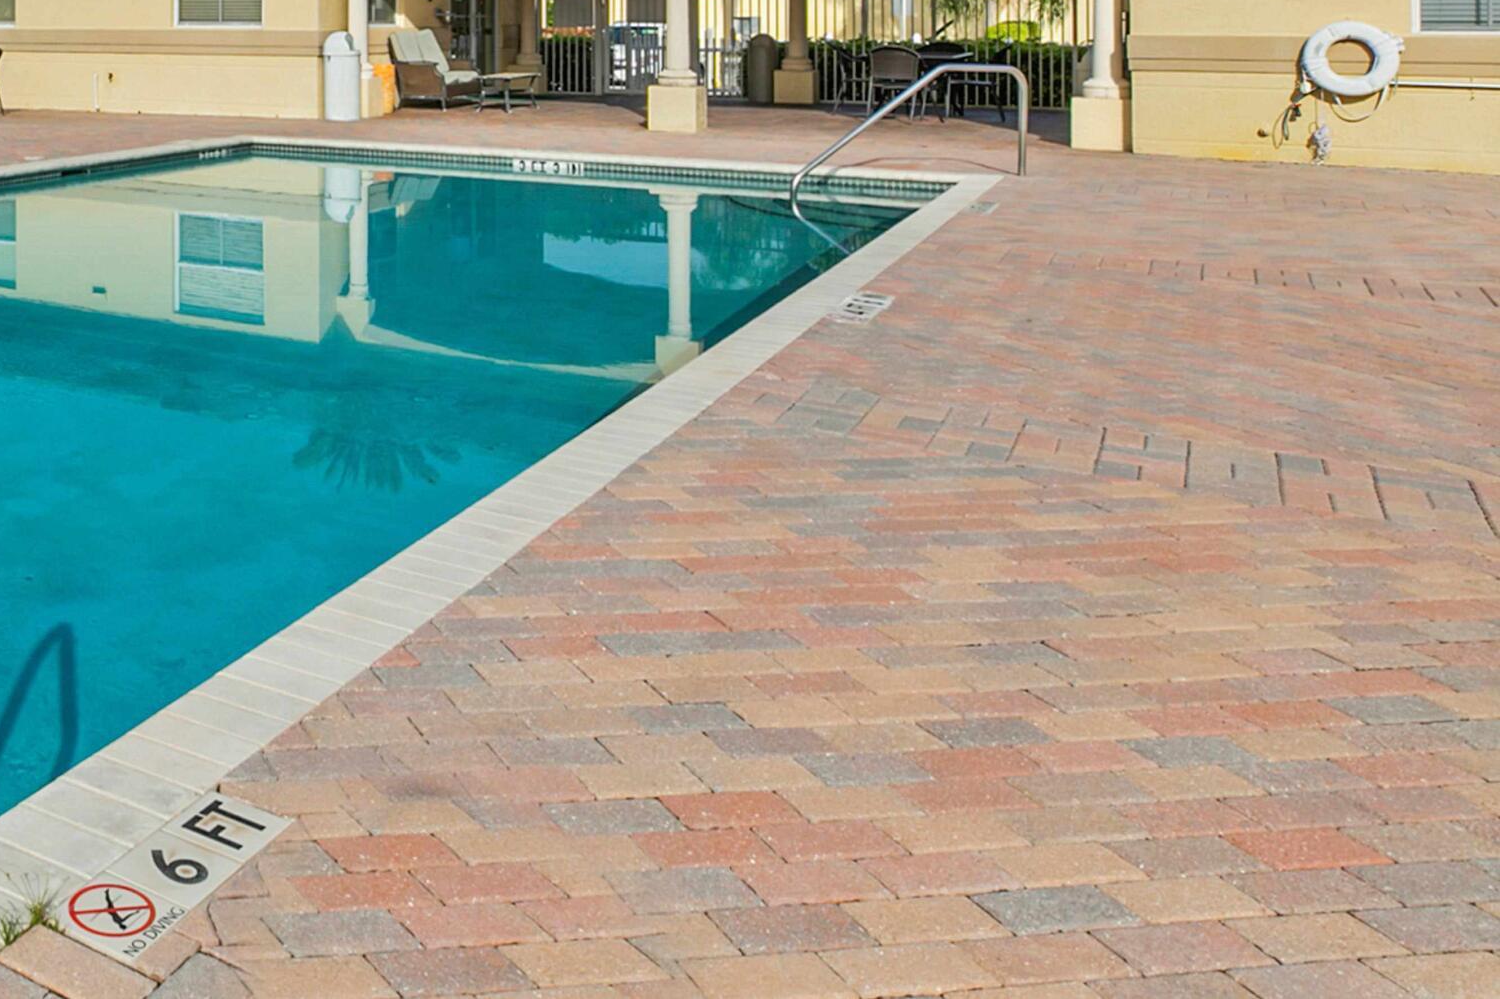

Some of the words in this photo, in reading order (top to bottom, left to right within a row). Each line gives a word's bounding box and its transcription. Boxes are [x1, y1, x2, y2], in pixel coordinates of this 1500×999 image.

[151, 849, 209, 884] 6
[182, 800, 267, 850] FT
[122, 938, 147, 958] NO
[142, 906, 186, 940] DIVING
